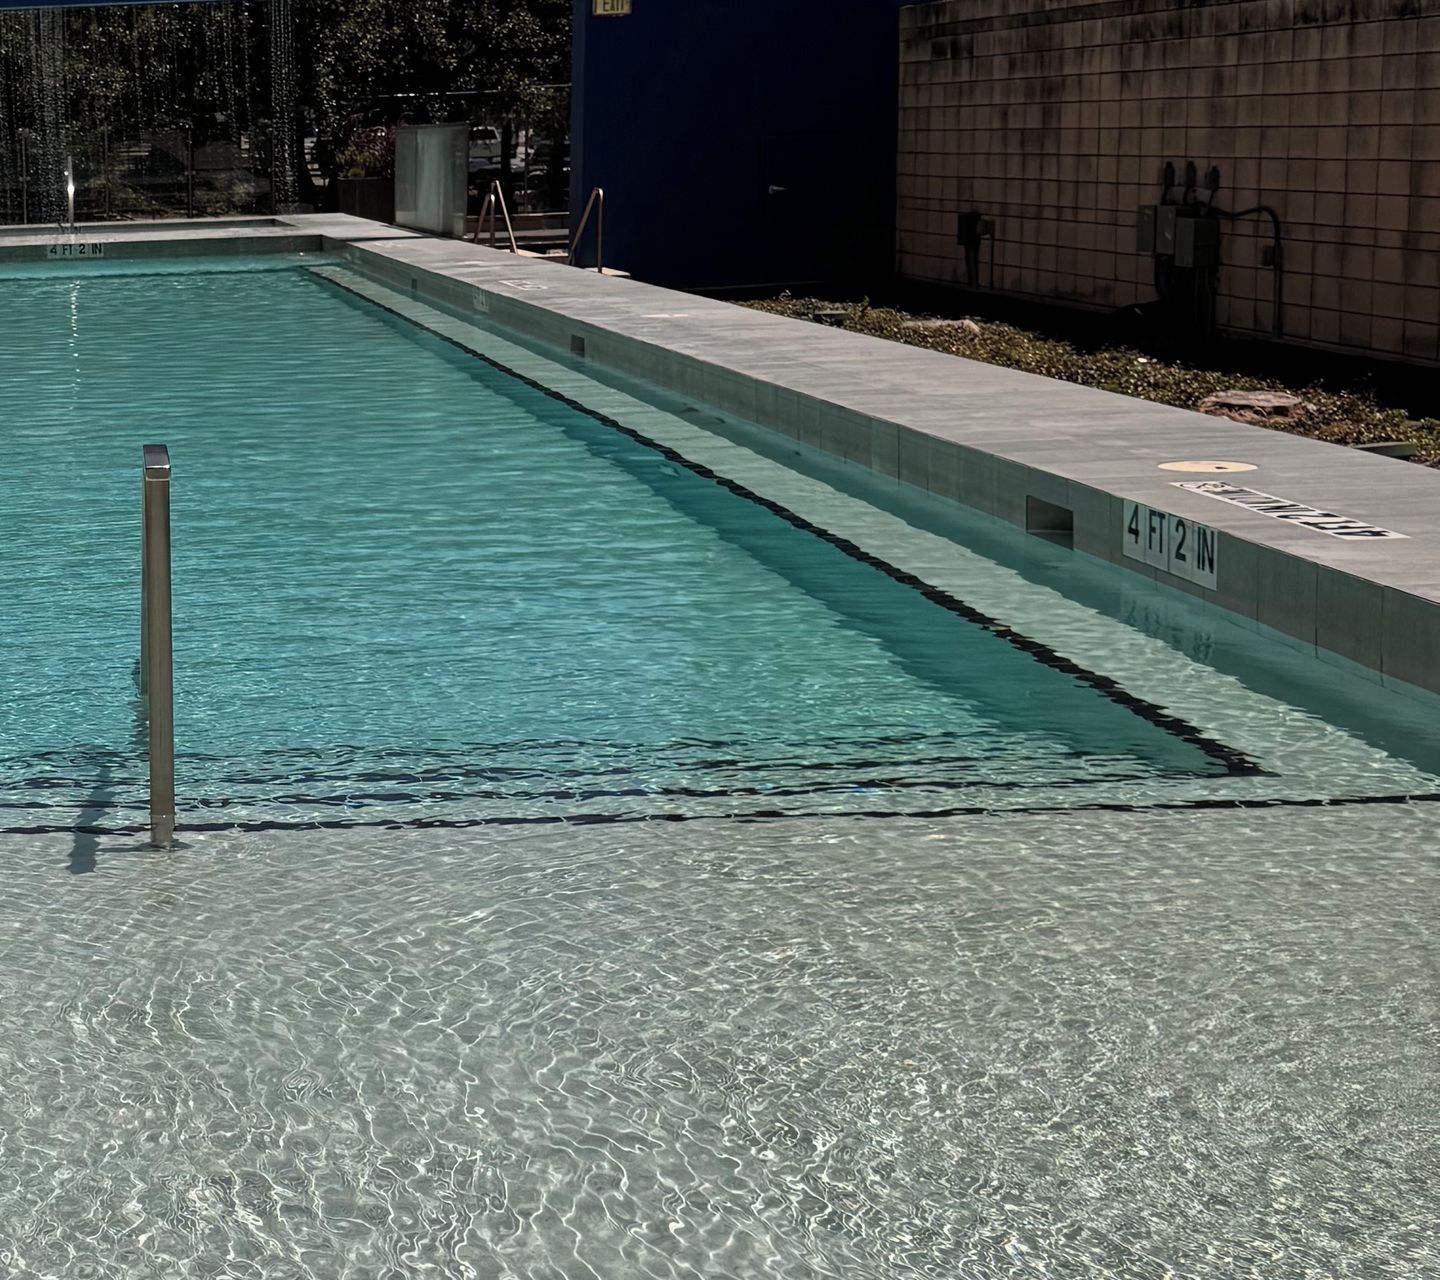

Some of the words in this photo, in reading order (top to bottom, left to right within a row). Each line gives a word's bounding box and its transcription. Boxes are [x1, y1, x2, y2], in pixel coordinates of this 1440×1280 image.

[50, 244, 57, 254] 4
[79, 243, 86, 254] 2
[91, 243, 102, 254] IN
[1127, 505, 1140, 544] 4
[1148, 510, 1166, 553] FT
[1175, 519, 1187, 562] 2
[1196, 525, 1215, 574] IN
